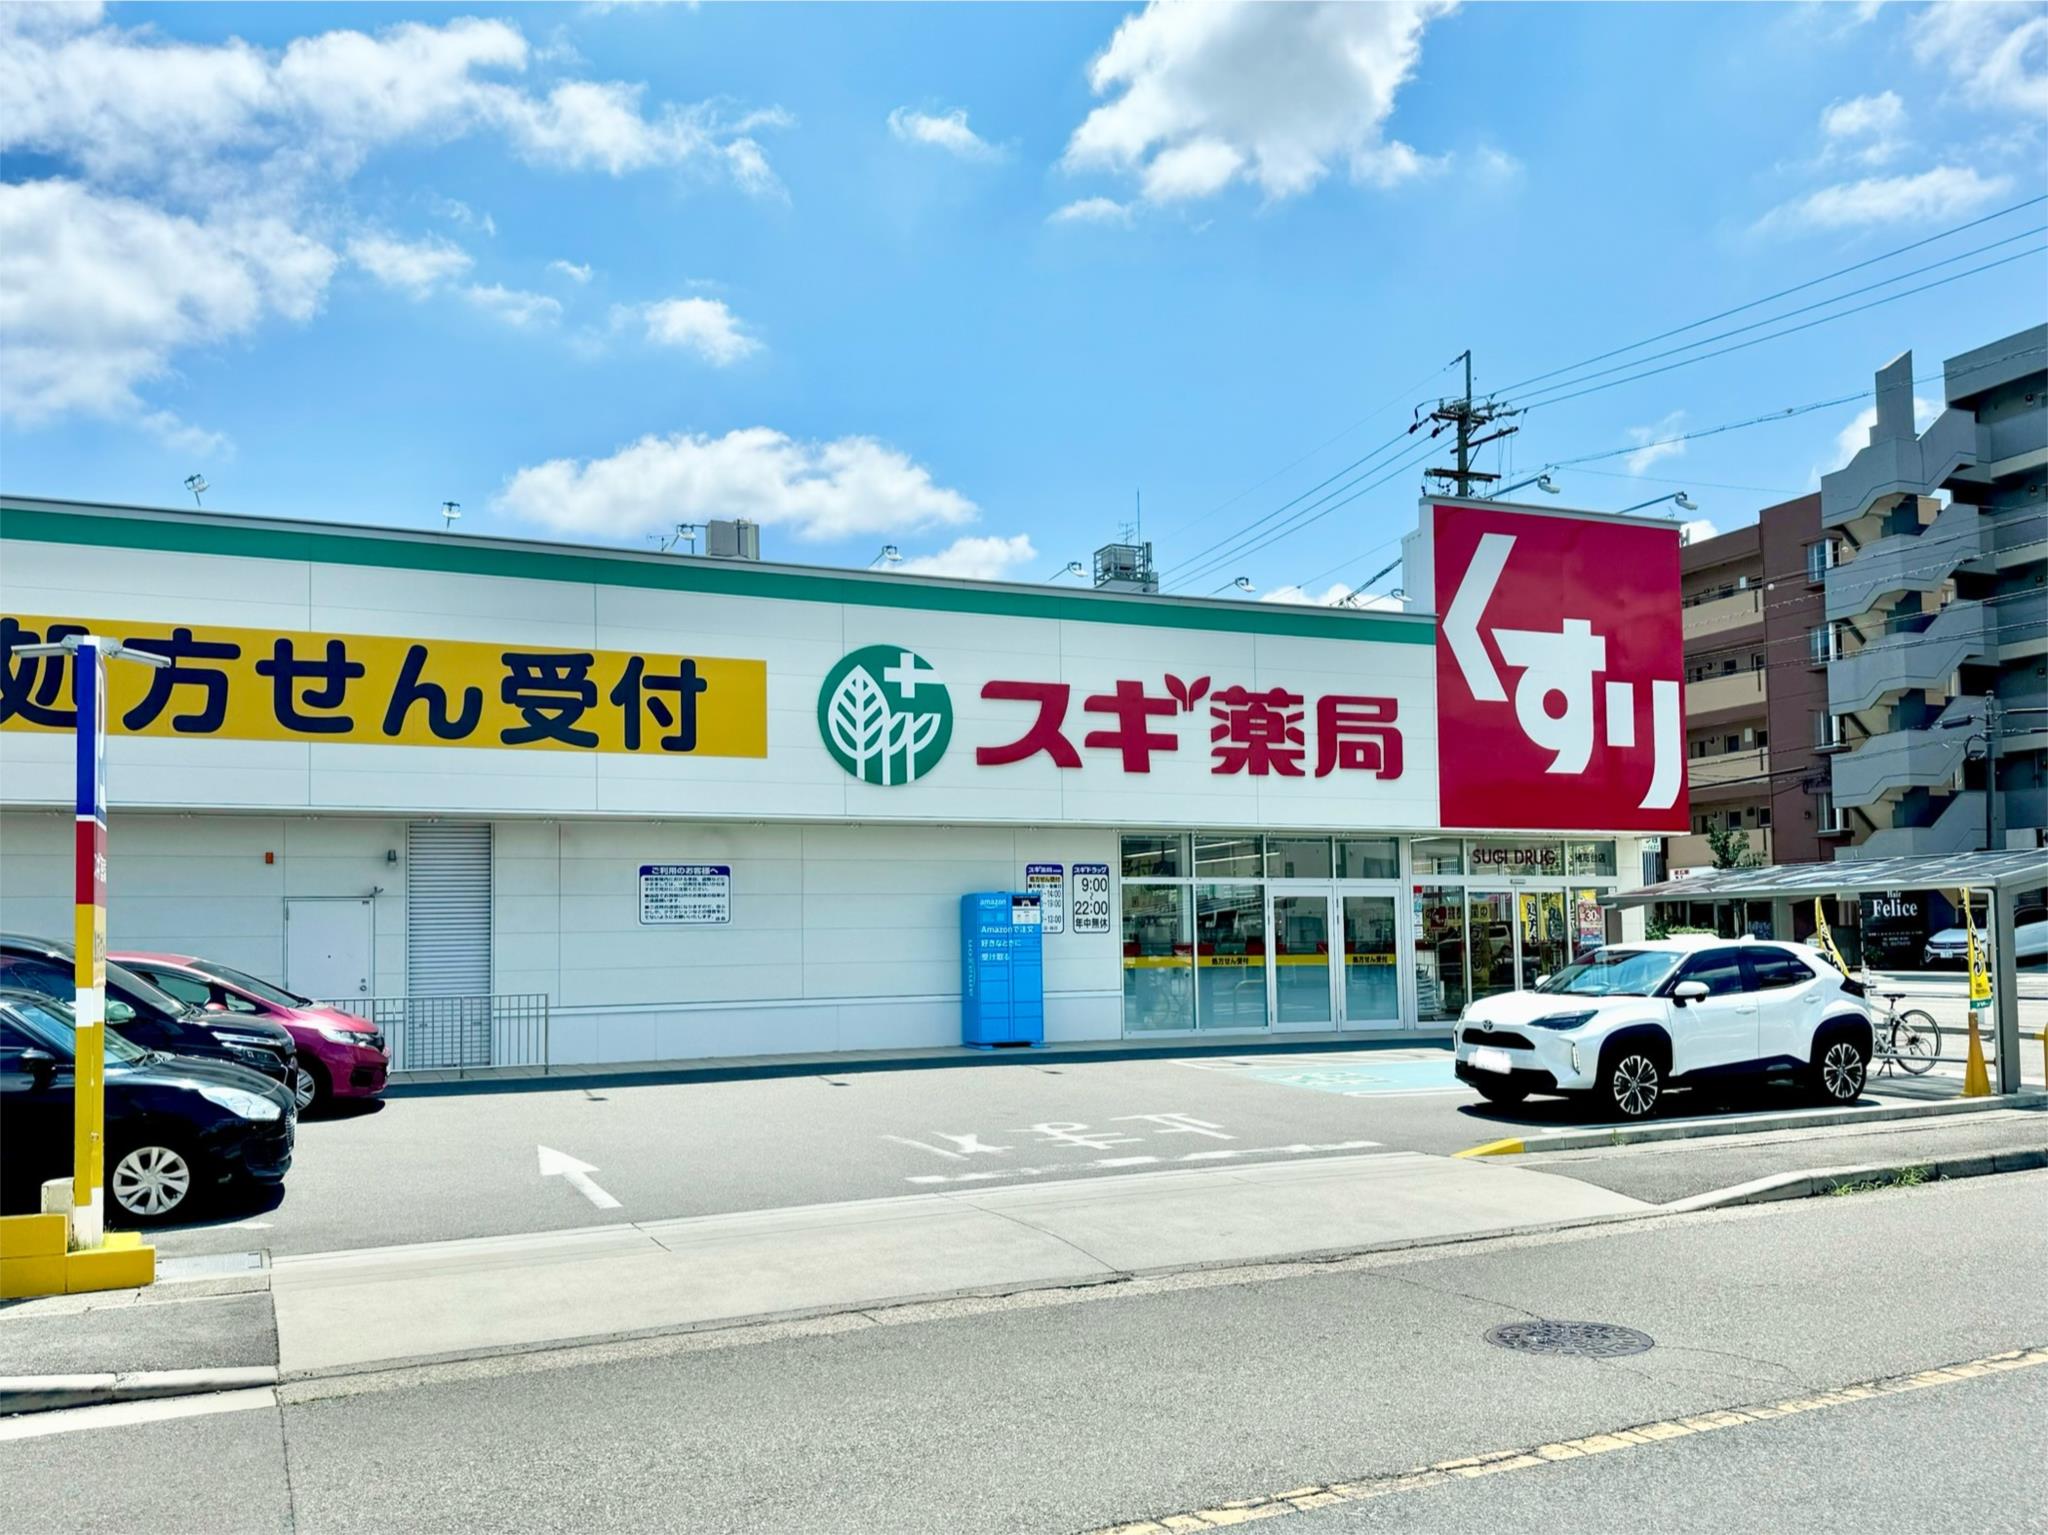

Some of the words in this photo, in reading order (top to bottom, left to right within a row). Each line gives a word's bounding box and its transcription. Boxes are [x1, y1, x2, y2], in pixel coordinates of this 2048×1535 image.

[1442, 532, 1681, 810] くすり
[0, 617, 708, 752] 処方せん受付
[976, 673, 1404, 781] スギ薬局
[1472, 848, 1508, 864] SUGI
[1514, 849, 1556, 865] DRUG
[652, 867, 718, 875] ご利用のお客様へ
[1082, 878, 1107, 892] 9:00
[980, 898, 1007, 906] amazon
[1075, 901, 1107, 915] 22:00
[1872, 899, 1918, 917] Felice
[1075, 917, 1108, 929] 年中無休
